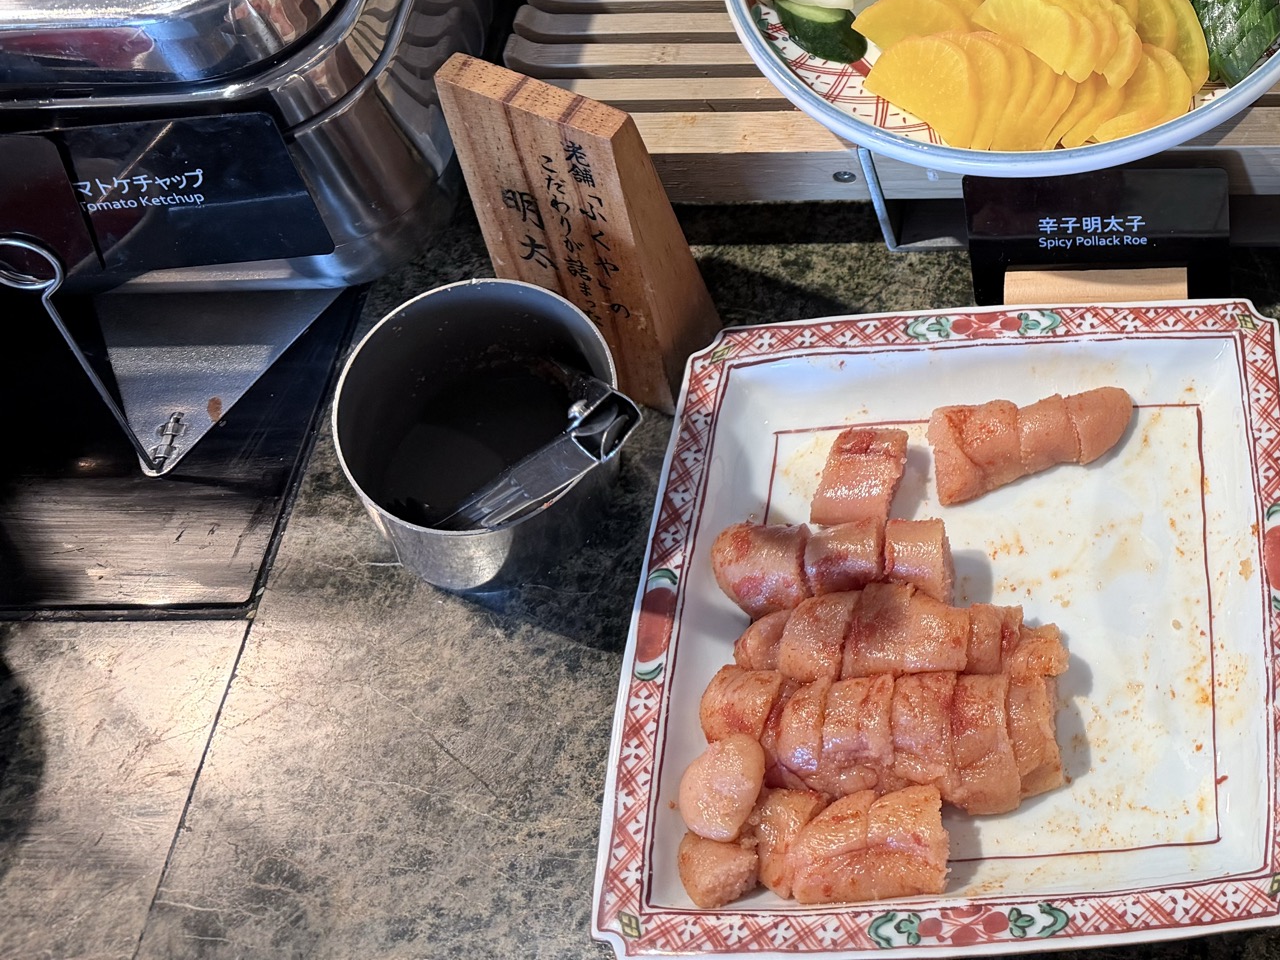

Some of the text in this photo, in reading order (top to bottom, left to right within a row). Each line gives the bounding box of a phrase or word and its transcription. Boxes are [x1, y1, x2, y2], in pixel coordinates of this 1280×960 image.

[72, 168, 204, 197] マトケチャップ
[139, 192, 205, 208] Ketchup
[502, 189, 559, 270] 明太
[1038, 215, 1146, 234] 辛子明太子
[1038, 235, 1148, 249] Spicy Pollack Roe
